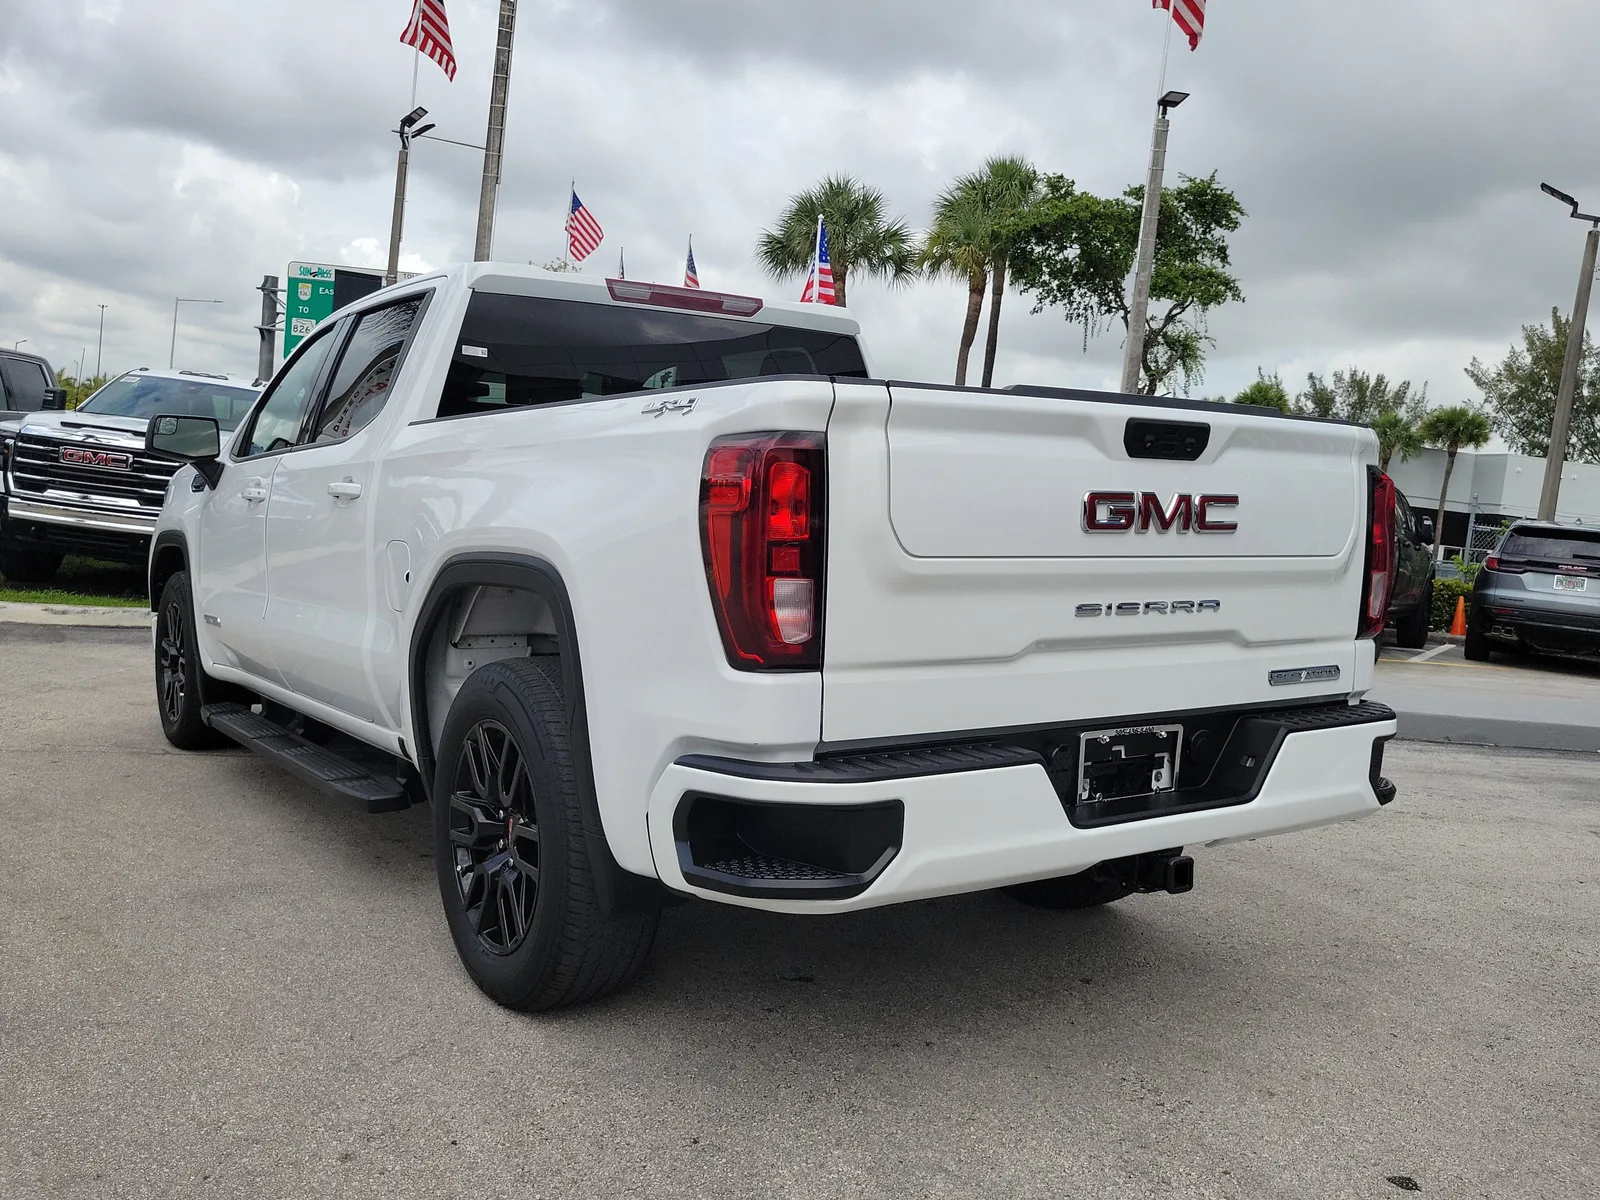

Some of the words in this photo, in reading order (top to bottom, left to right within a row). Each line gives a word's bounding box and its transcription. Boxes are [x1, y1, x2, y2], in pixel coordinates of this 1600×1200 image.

[298, 305, 310, 314] TO
[293, 324, 311, 334] 826
[63, 448, 128, 468] GMC
[1080, 489, 1240, 534] GMC
[1074, 599, 1221, 617] SIERRA
